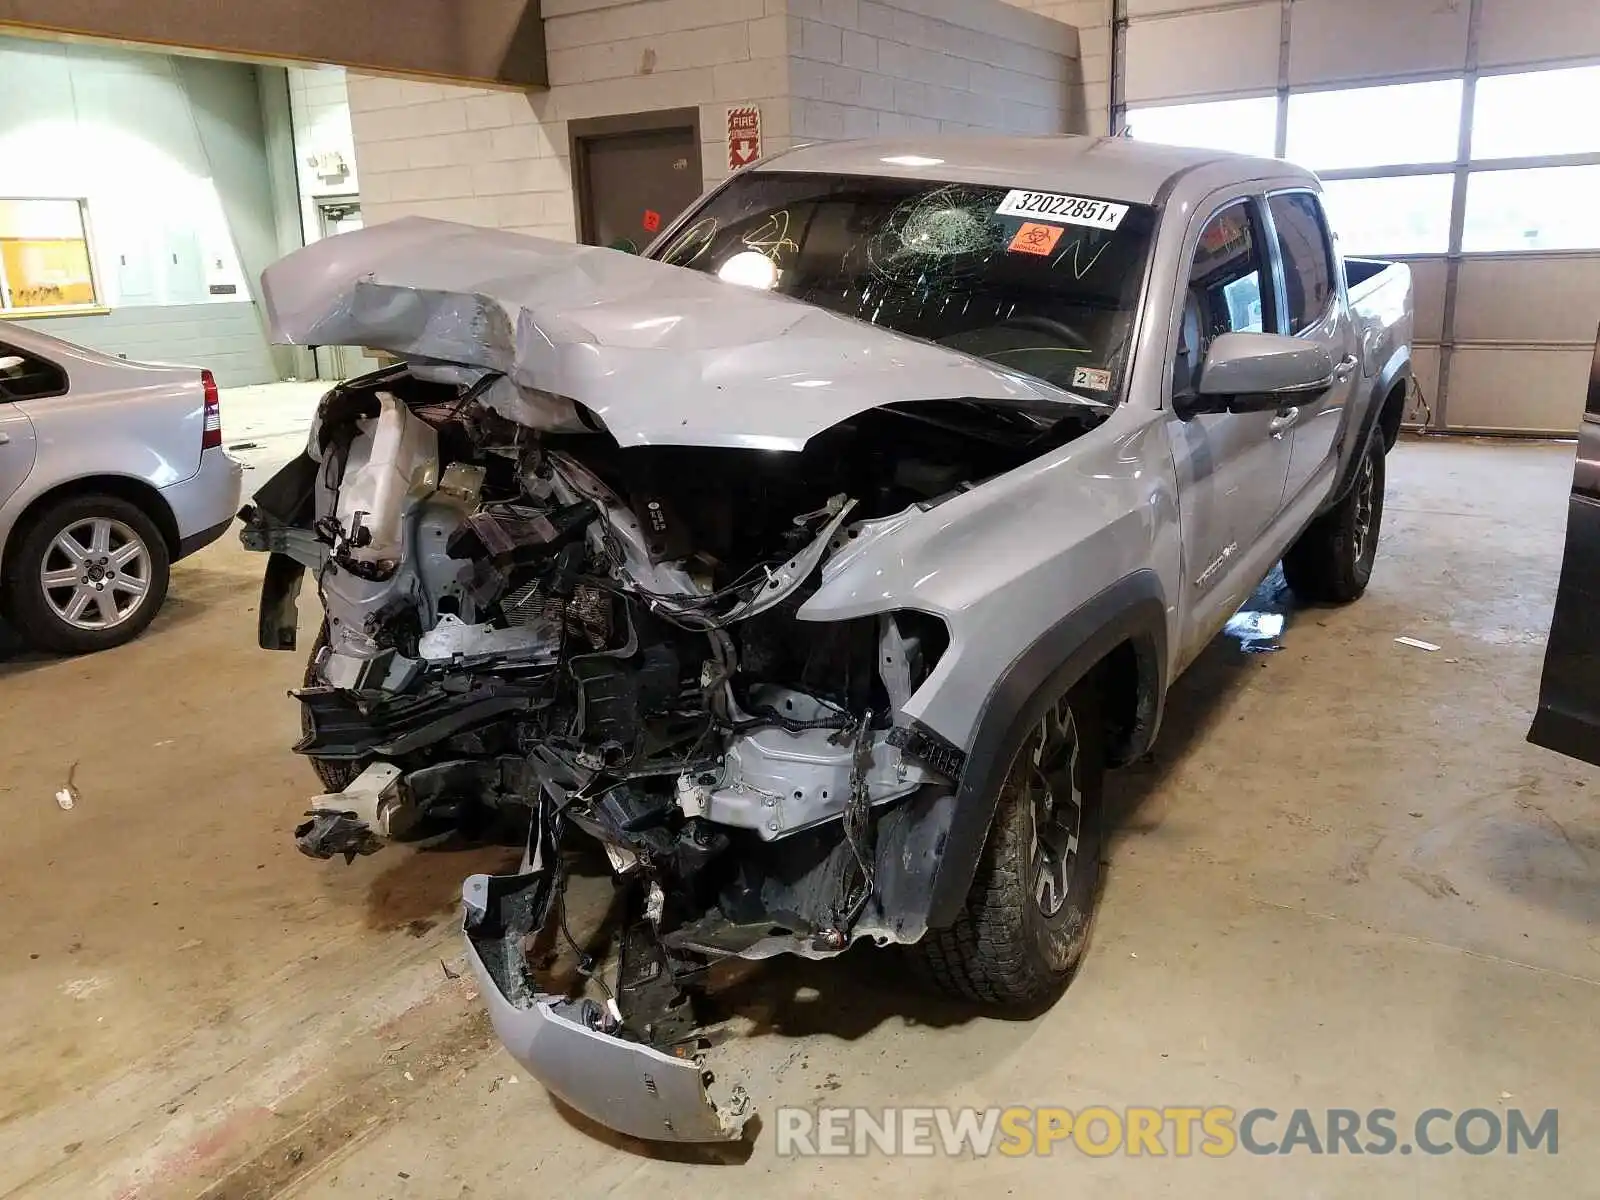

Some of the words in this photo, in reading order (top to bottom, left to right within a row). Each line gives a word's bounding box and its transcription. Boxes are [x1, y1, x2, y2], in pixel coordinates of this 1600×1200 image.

[733, 115, 755, 127] FIRE
[1015, 193, 1110, 221] 32022851
[1077, 371, 1087, 384] 2
